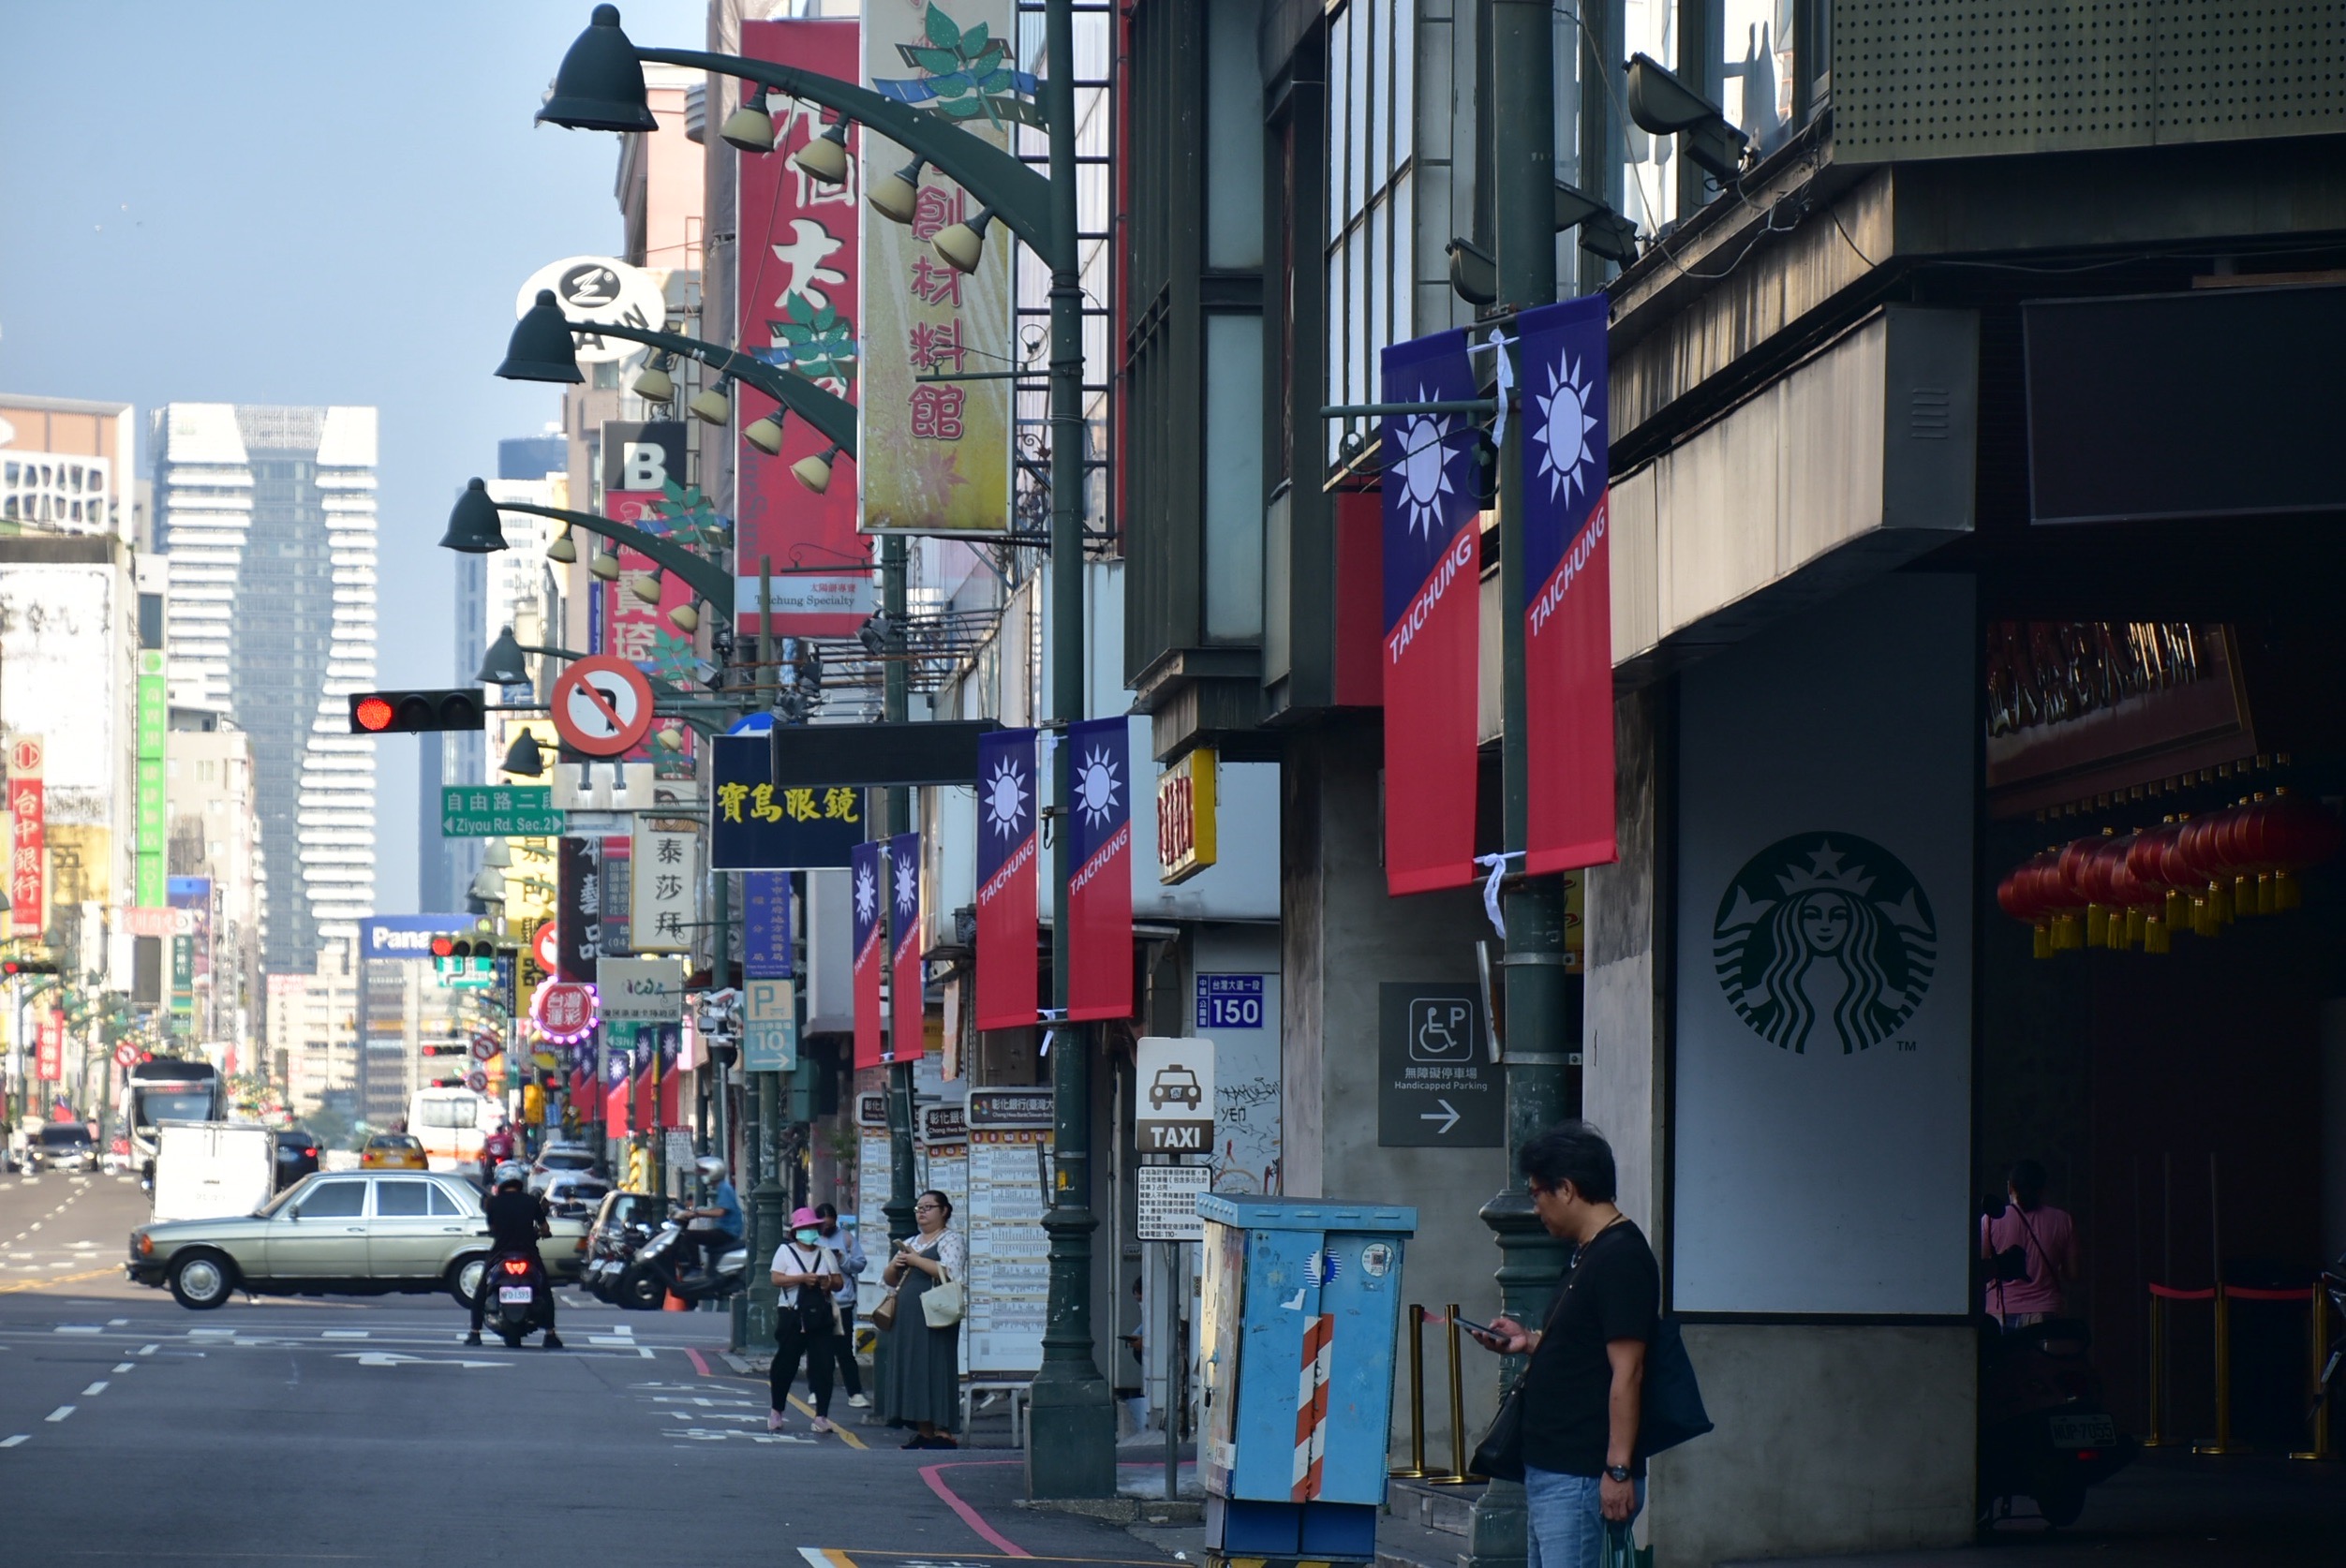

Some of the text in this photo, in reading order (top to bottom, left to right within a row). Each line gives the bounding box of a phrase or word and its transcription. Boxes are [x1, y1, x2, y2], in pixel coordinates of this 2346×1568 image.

[907, 161, 967, 440] 創材料館
[623, 442, 667, 490] B
[1530, 505, 1606, 637] TAICHUNG
[754, 595, 855, 607] Tichung Specialty
[1388, 533, 1473, 664] TAICHUNG
[717, 781, 859, 824] 寶島眼鏡
[456, 817, 551, 835] Ziyou Rd. Sec.2
[13, 789, 41, 905] 台中銀行
[1070, 829, 1128, 896] TAICHUNG
[980, 839, 1034, 907] TAICHUNG
[854, 924, 879, 976] TAICHUNG
[894, 917, 919, 968] TAICHUNG
[754, 985, 774, 1017] P
[1213, 998, 1258, 1024] 150
[755, 1030, 784, 1051] 10
[1896, 1041, 1917, 1052] TM
[1394, 1081, 1488, 1091] Handicapped Parking
[1405, 1067, 1477, 1079] 無障礙停車場
[865, 1100, 884, 1111] 彰化
[1150, 1127, 1200, 1148] TAXI
